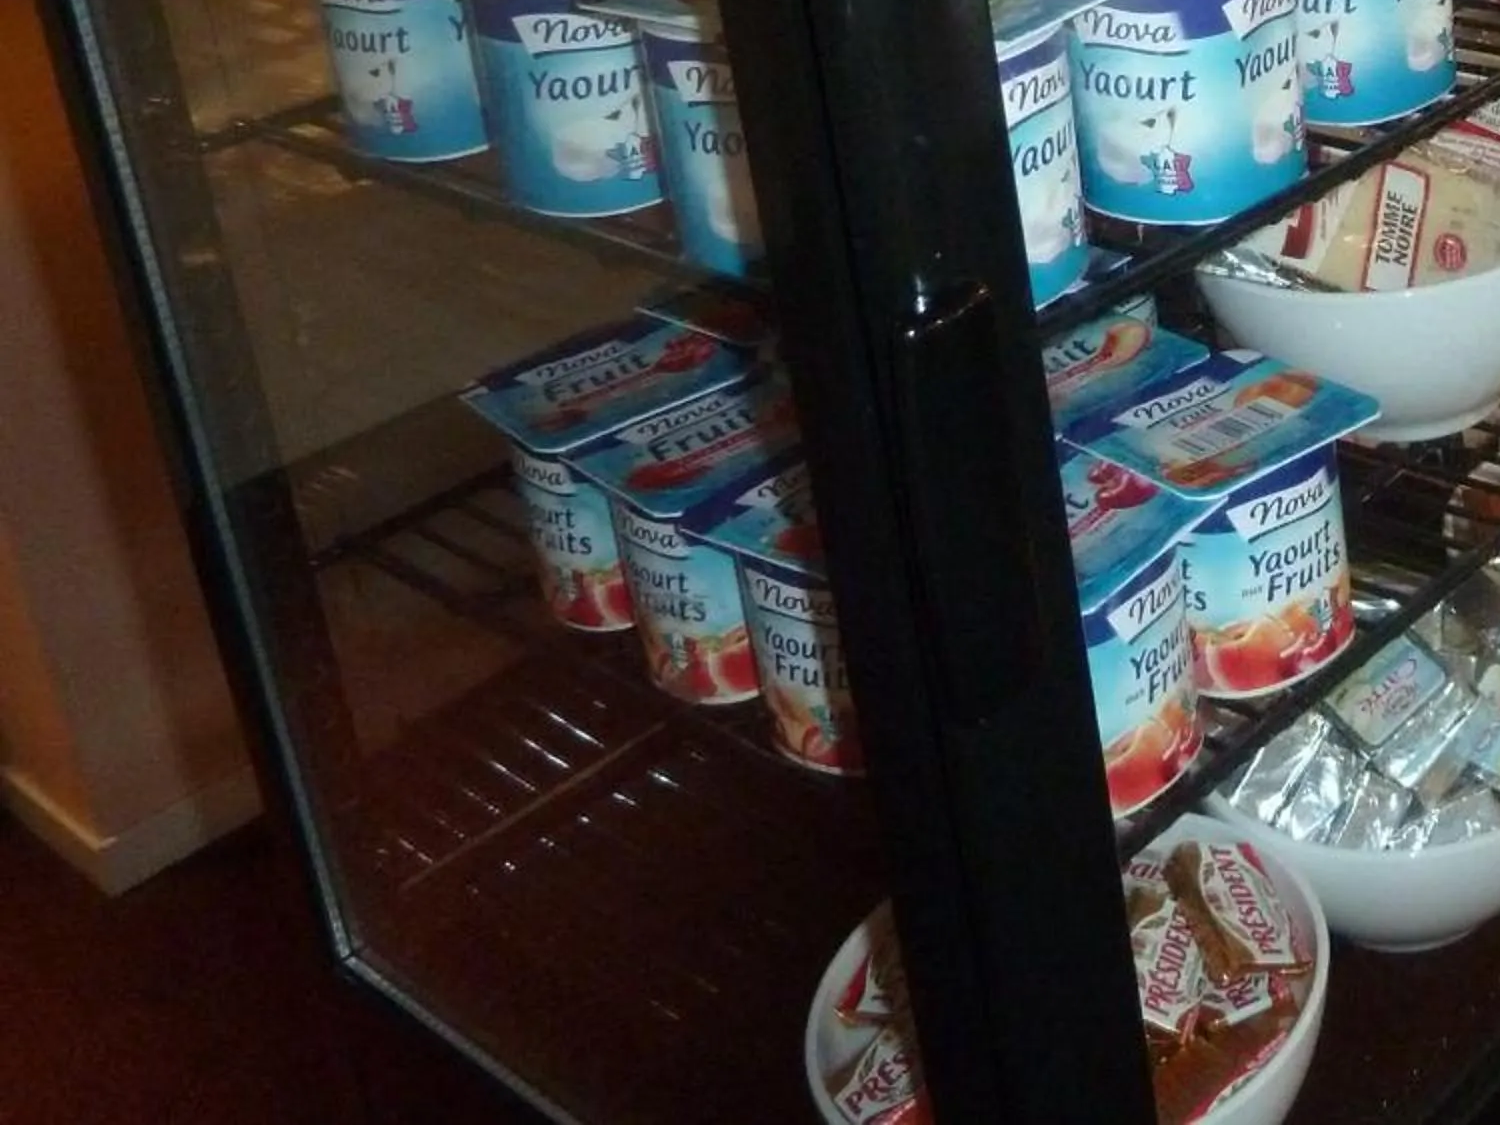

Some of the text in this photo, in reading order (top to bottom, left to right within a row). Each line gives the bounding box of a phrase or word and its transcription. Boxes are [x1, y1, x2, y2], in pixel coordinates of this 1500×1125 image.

[333, 26, 411, 54] aourt
[1082, 9, 1177, 44] Nova
[528, 65, 642, 102] Yaour
[1079, 60, 1197, 102] Yaourt
[684, 120, 743, 156] Yao
[1375, 190, 1403, 265] TOMME
[1391, 202, 1418, 268] NOIRE
[543, 354, 650, 403] Fruit
[636, 398, 724, 437] Nova
[1133, 384, 1216, 419] Nova
[650, 408, 755, 462] Fruit
[1250, 481, 1325, 526] Nova
[1249, 520, 1331, 578] Yaourt
[1267, 541, 1342, 602] Fruits
[765, 624, 839, 663] Yaour
[1209, 845, 1283, 956] PRÉSIDENT
[1144, 911, 1195, 1017] PRÉSIDEN
